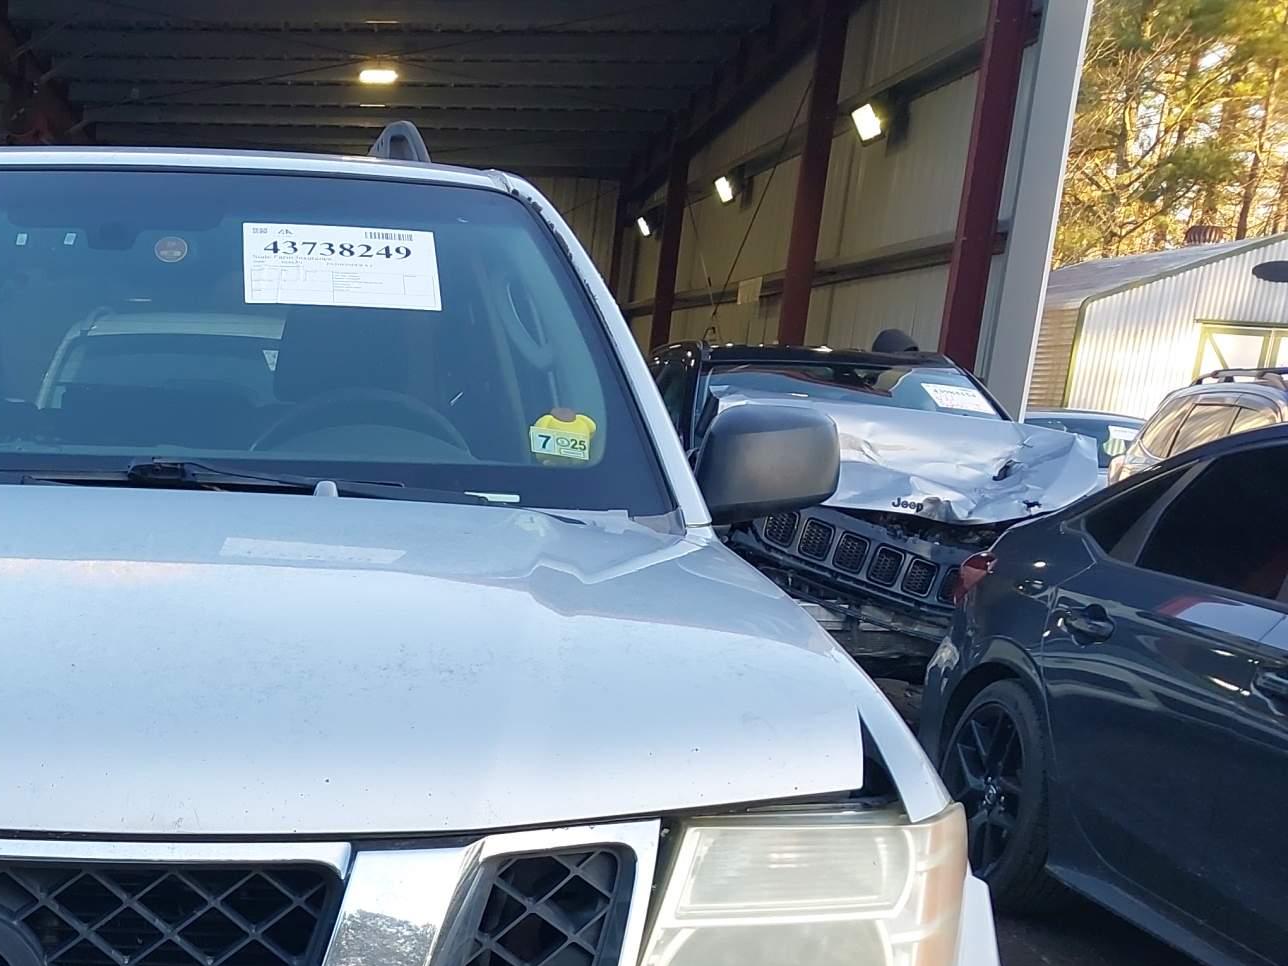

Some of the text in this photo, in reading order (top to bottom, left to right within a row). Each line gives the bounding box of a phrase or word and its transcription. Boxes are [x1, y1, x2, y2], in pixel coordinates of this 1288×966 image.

[263, 239, 413, 261] 43738249
[538, 434, 587, 451] 7 25
[892, 497, 924, 513] Jeep
